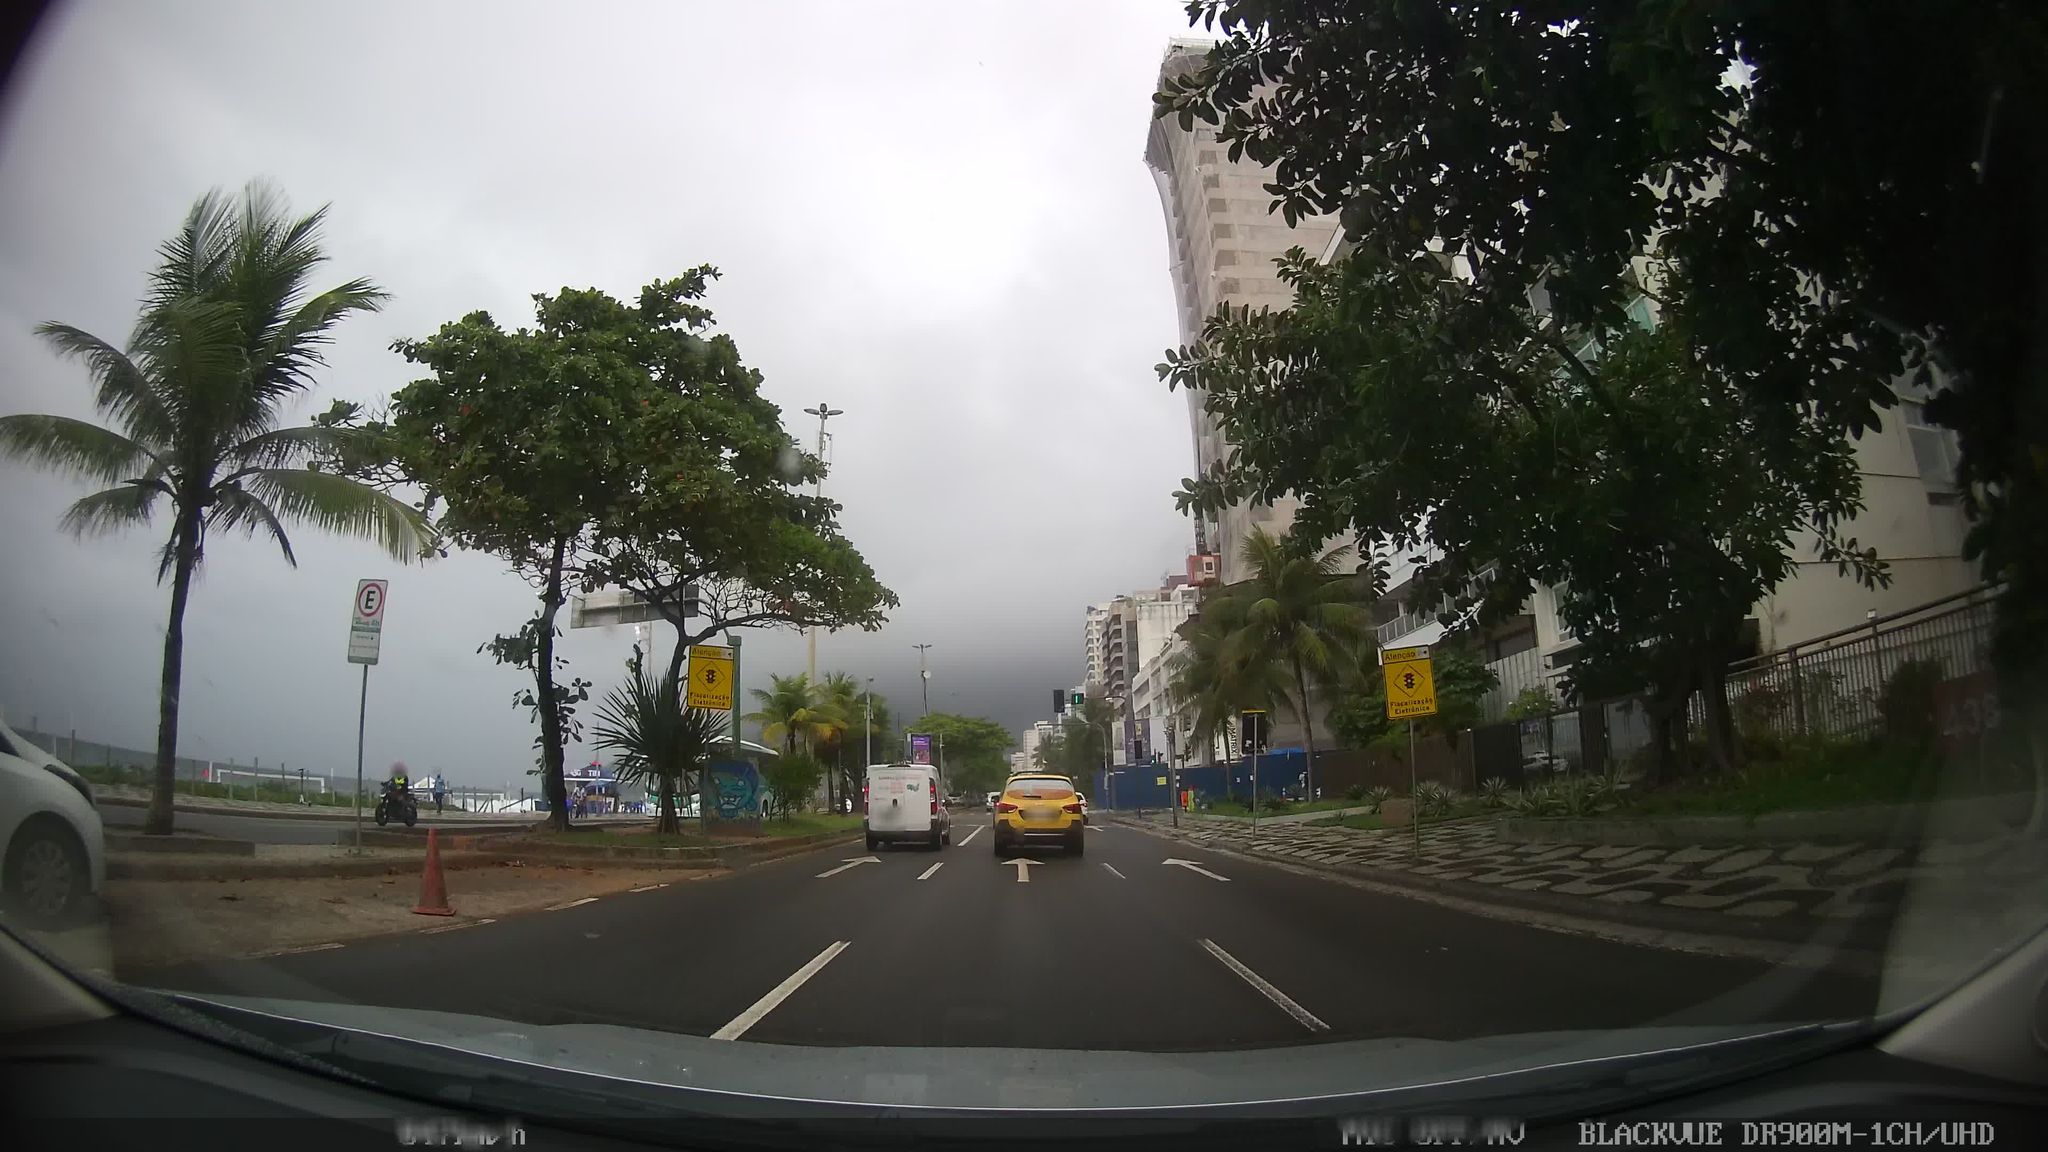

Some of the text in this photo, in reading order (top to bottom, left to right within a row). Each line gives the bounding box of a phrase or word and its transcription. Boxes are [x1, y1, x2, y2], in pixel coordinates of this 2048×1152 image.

[364, 590, 376, 609] E
[1385, 651, 1416, 661] Atenção
[690, 692, 730, 701] Fiscalização
[1391, 697, 1433, 708] Fiscalização
[1394, 706, 1430, 715] Eletrônica
